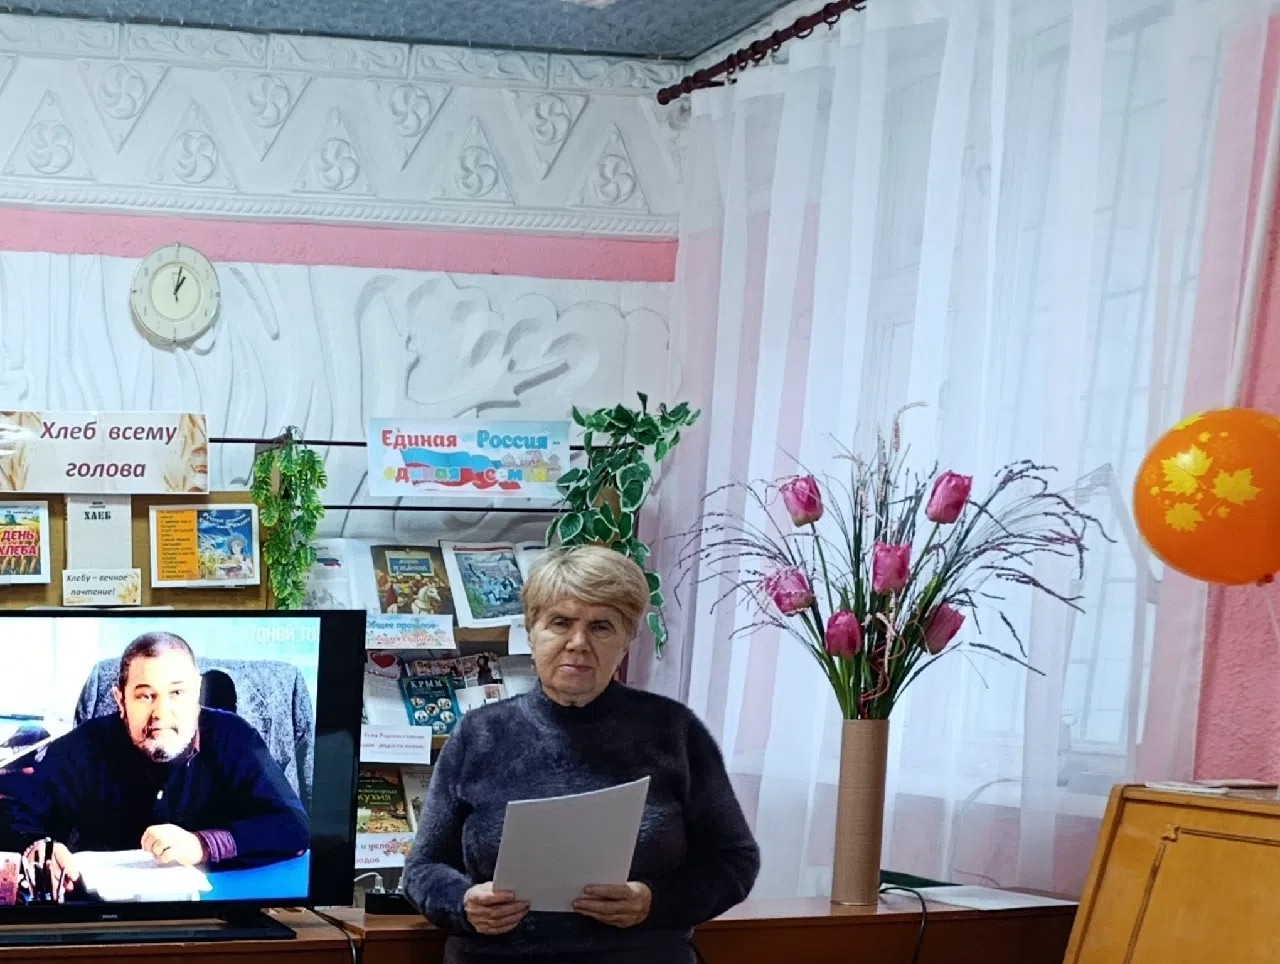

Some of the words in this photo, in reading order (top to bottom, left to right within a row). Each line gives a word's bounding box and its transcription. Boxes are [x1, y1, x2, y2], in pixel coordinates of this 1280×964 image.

[40, 421, 97, 440] Хлеб
[108, 426, 177, 445] всему
[381, 429, 457, 450] Единая
[476, 430, 548, 450] Россия
[66, 462, 147, 478] голова
[1, 530, 35, 543] ДЕНЬ
